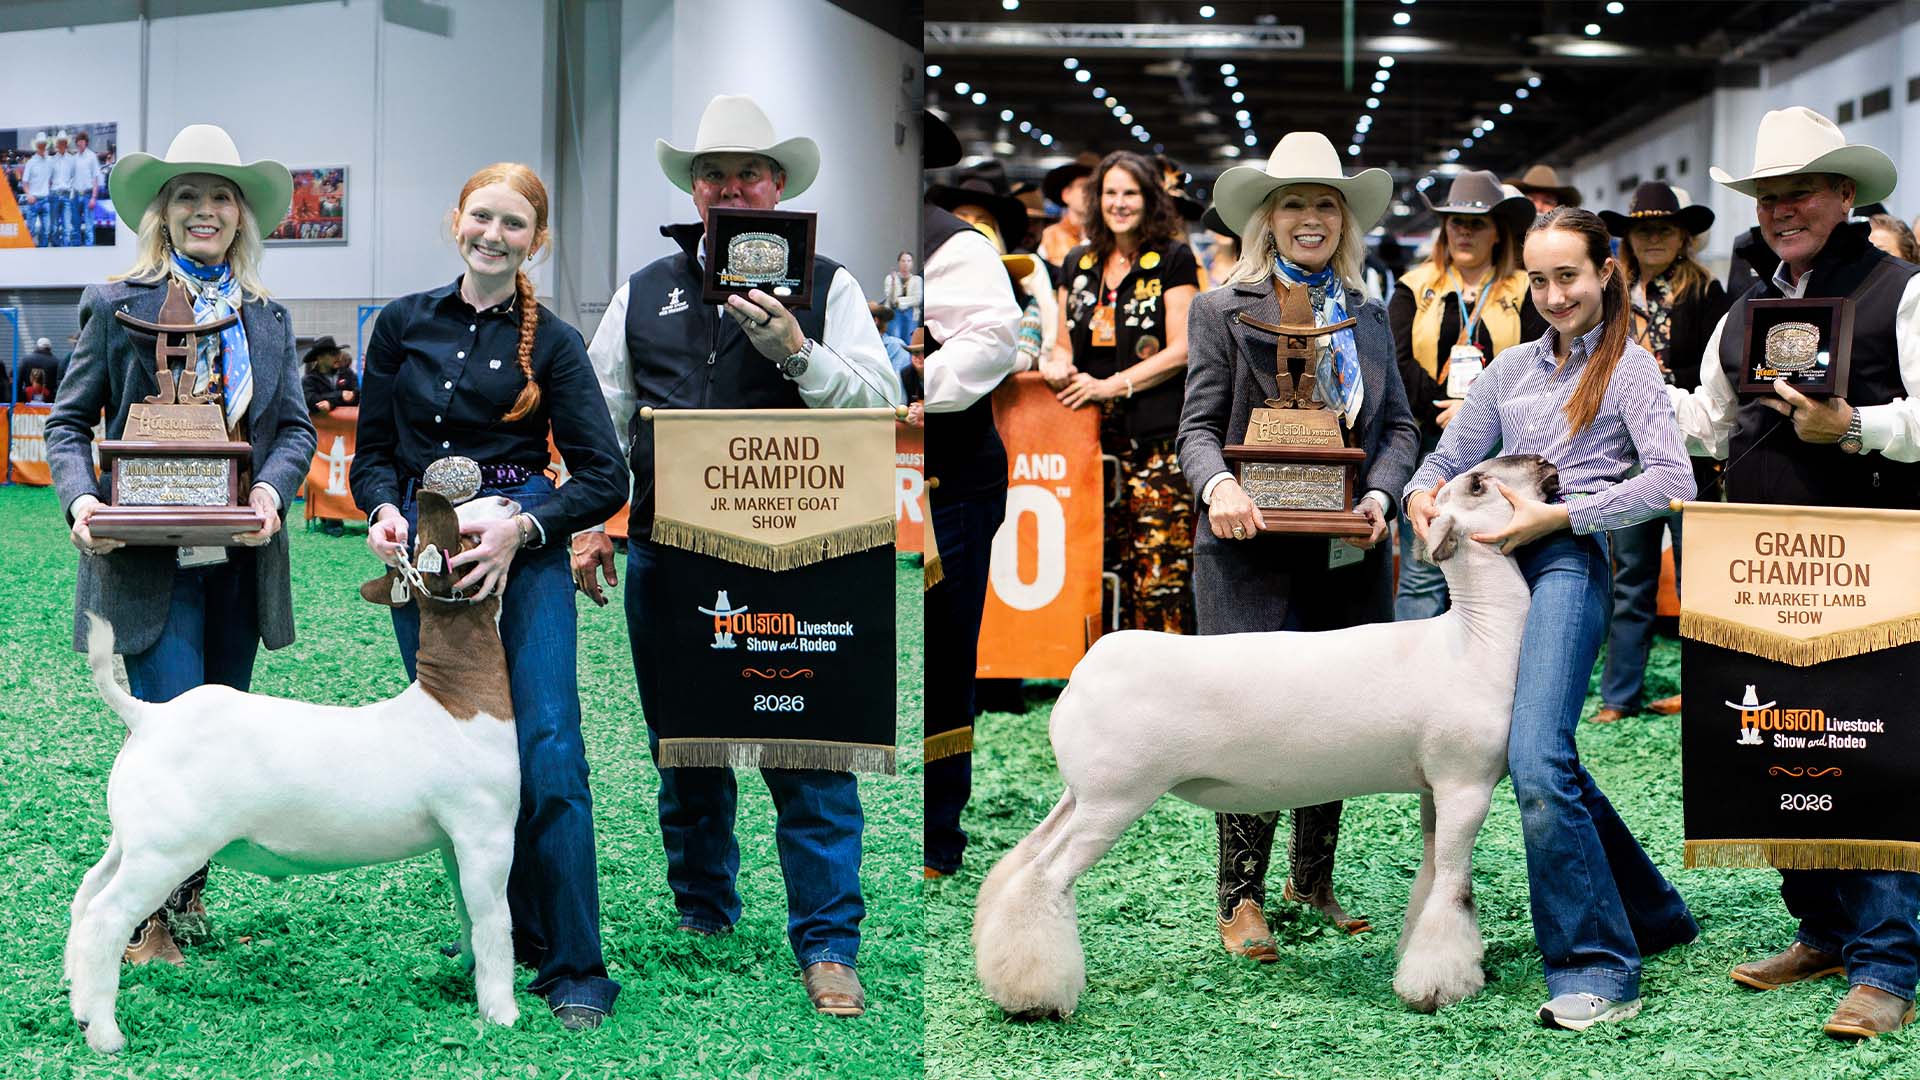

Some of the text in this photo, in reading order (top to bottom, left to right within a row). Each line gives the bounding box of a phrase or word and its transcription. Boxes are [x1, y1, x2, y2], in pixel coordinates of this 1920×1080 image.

[729, 436, 820, 461] GRAND
[496, 469, 517, 479] PA
[1013, 453, 1067, 480] AND
[704, 464, 845, 490] CHAMPION
[710, 496, 840, 511] JR. MARKET GOAT
[752, 515, 797, 529] SHOW
[1755, 531, 1846, 559] GRAND
[1729, 559, 1870, 587] CHAMPION
[1734, 591, 1867, 607] JR. MARKET LAMB
[1777, 611, 1823, 625] SHOW
[797, 621, 854, 636] Livestock
[747, 637, 837, 652] Show and Rodeo
[753, 694, 805, 712] 2026
[1826, 717, 1885, 733] Livestock
[1773, 733, 1867, 749] Show and Rodeo
[1780, 793, 1833, 811] 2026
